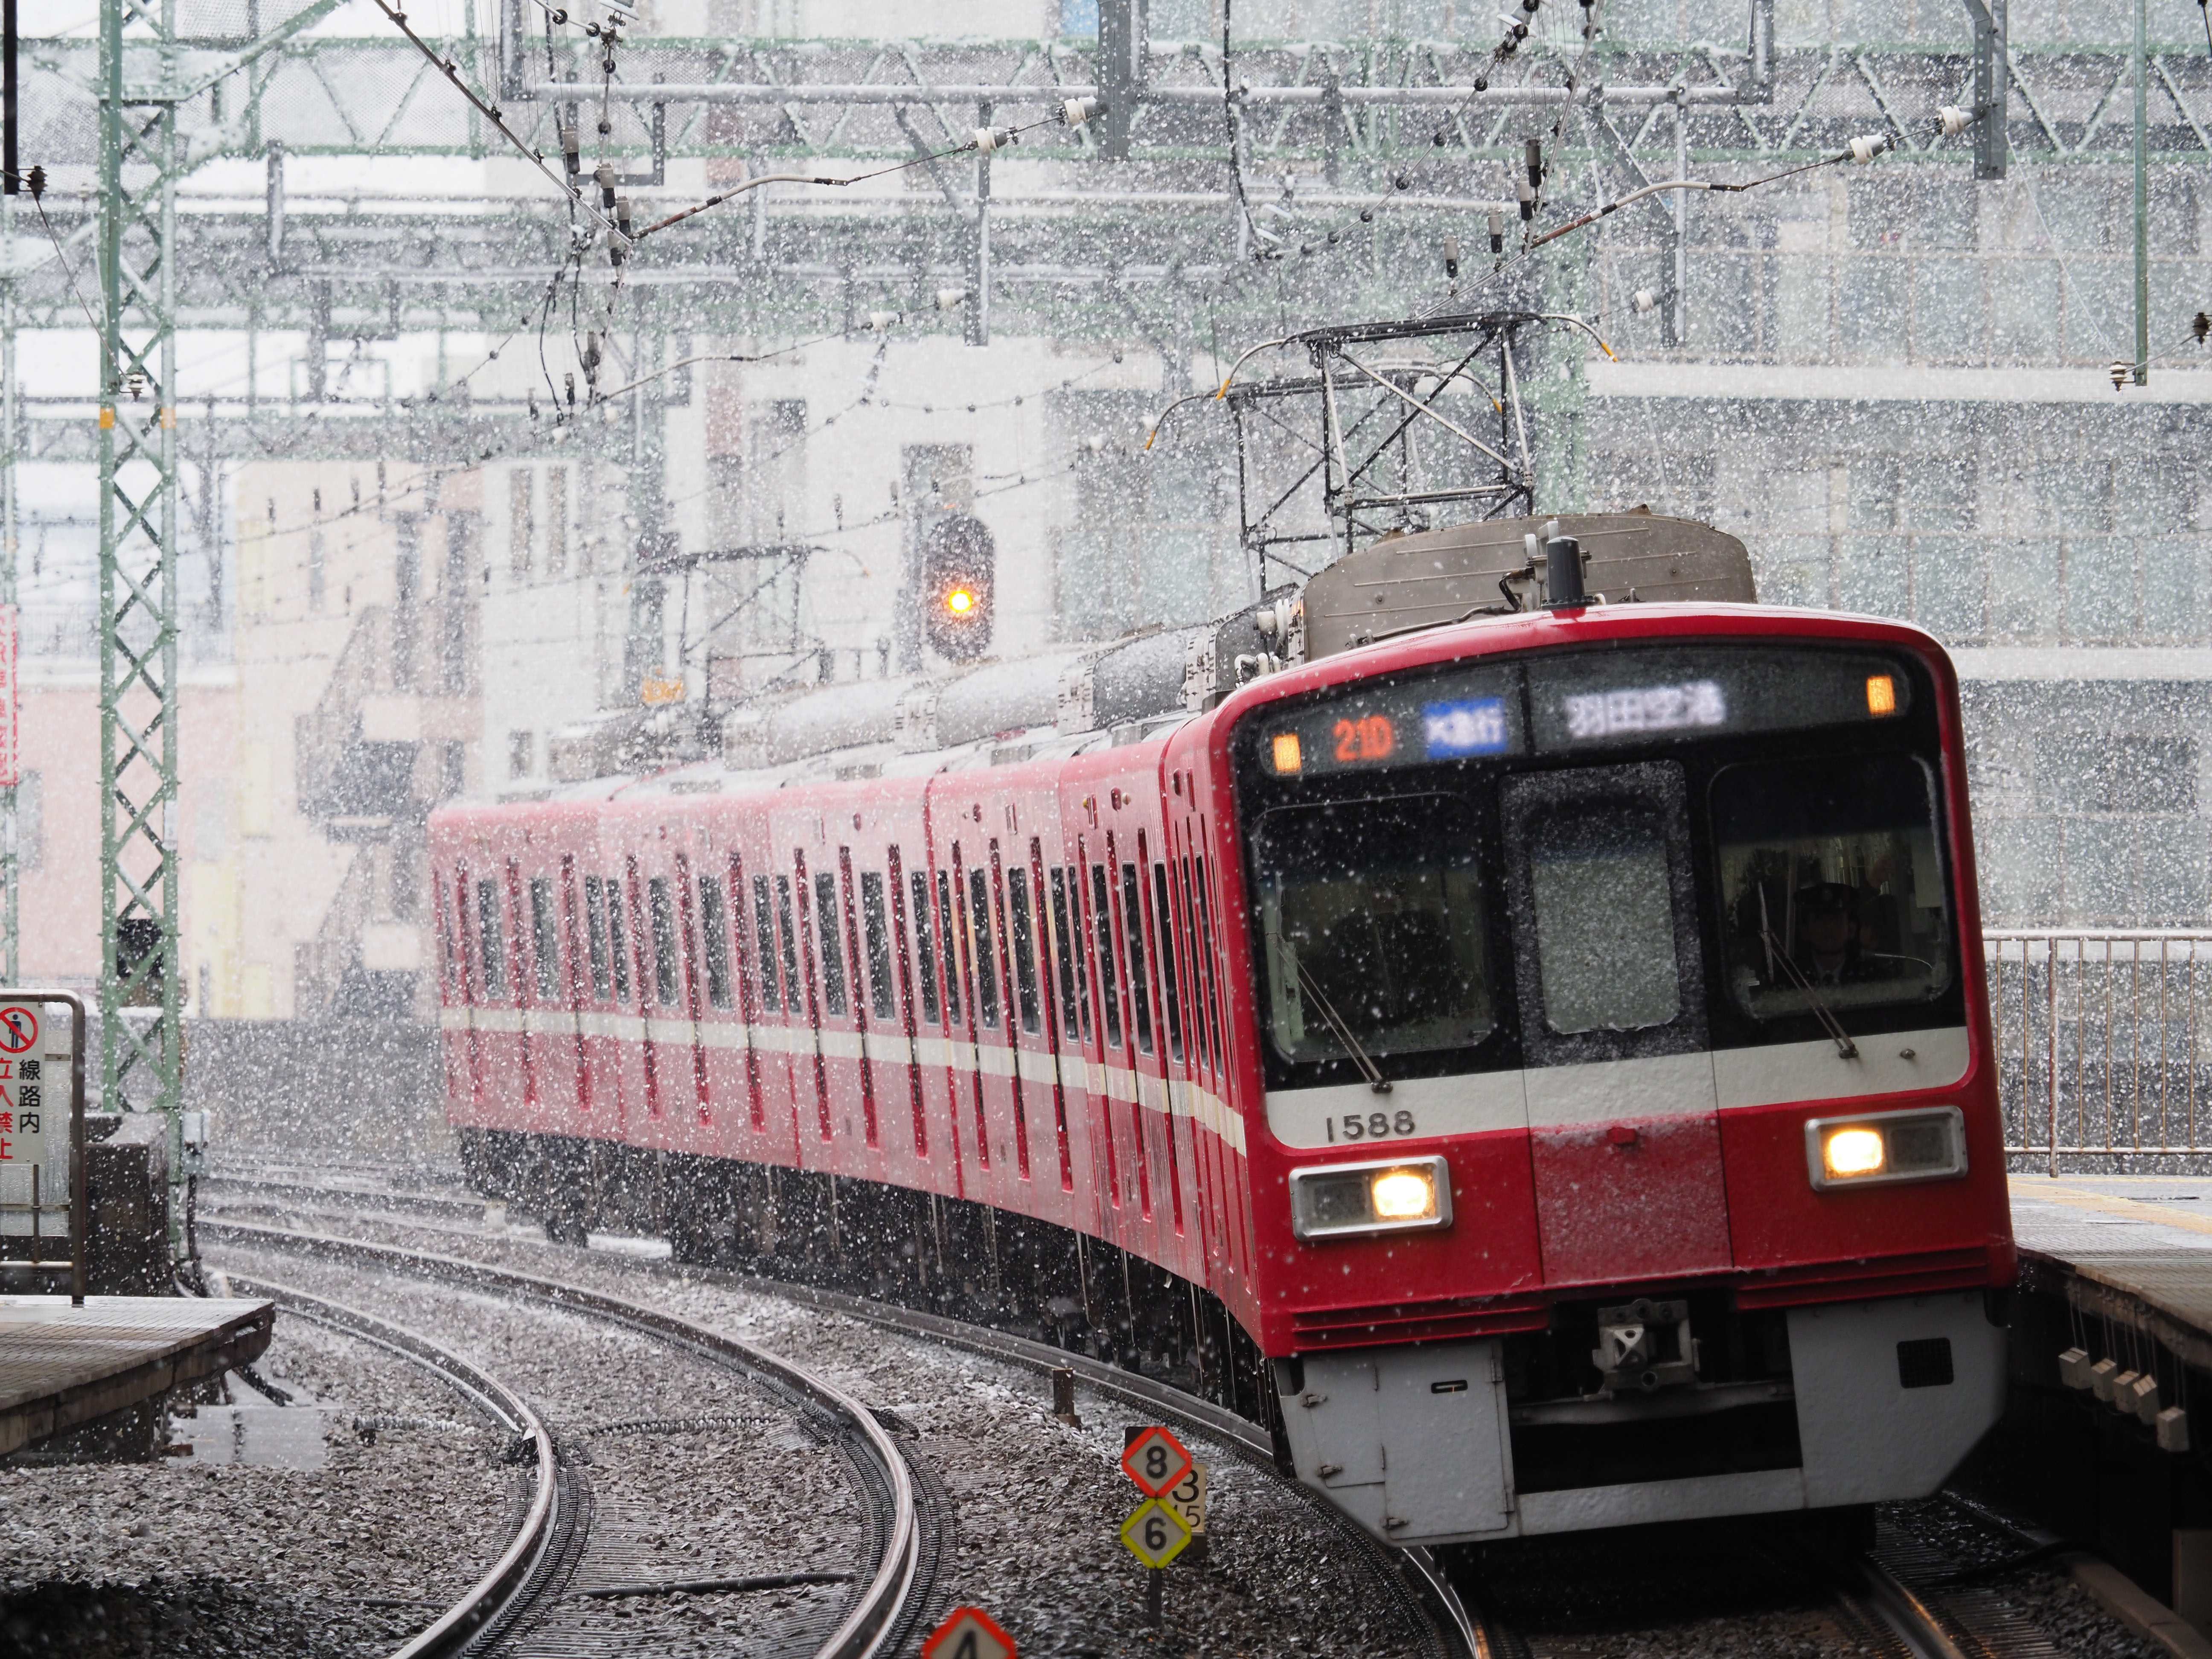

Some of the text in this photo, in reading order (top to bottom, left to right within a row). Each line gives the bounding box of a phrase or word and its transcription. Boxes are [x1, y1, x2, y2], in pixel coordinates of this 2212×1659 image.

[19, 1059, 41, 1134] 線路内
[1326, 1110, 1416, 1143] 1588
[1146, 1445, 1168, 1479] 8
[1172, 1469, 1199, 1503] 3
[1145, 1517, 1167, 1551] 6
